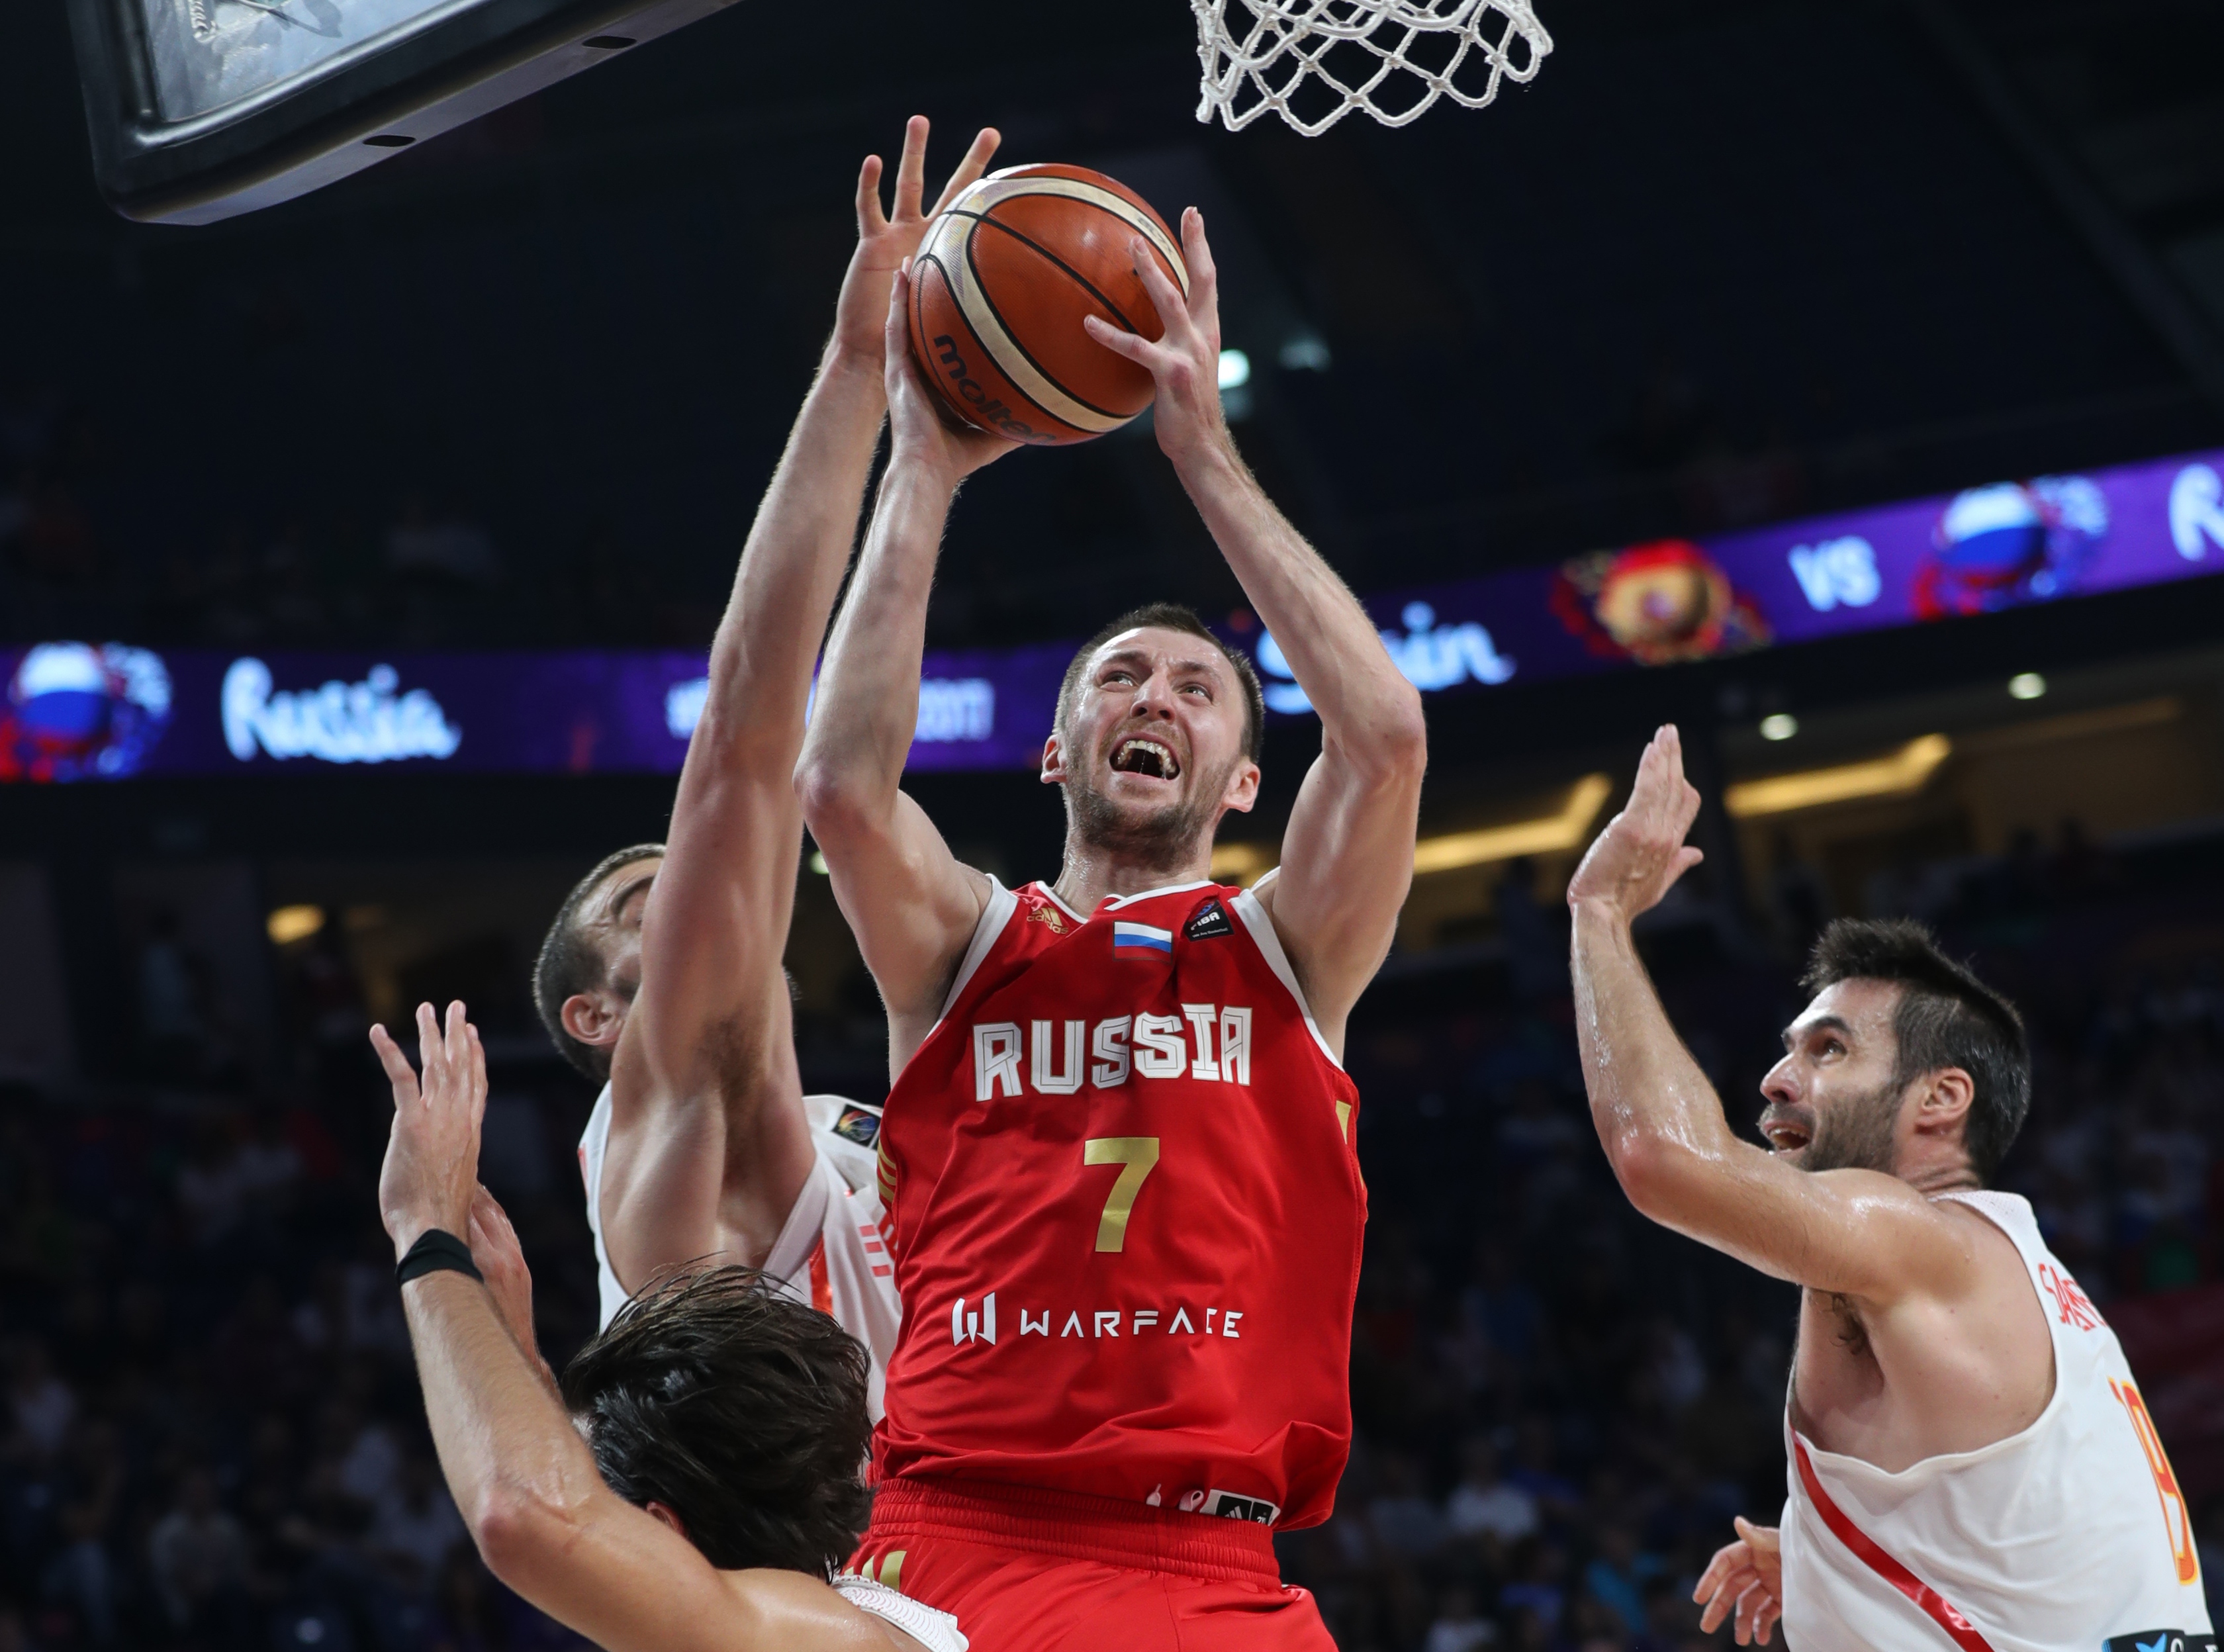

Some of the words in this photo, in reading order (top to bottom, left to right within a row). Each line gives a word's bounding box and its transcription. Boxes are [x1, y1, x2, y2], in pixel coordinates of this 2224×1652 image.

[972, 1003, 1253, 1103] RUSSIA
[1084, 1136, 1160, 1253] 7
[1020, 1306, 1244, 1338] WARFACE
